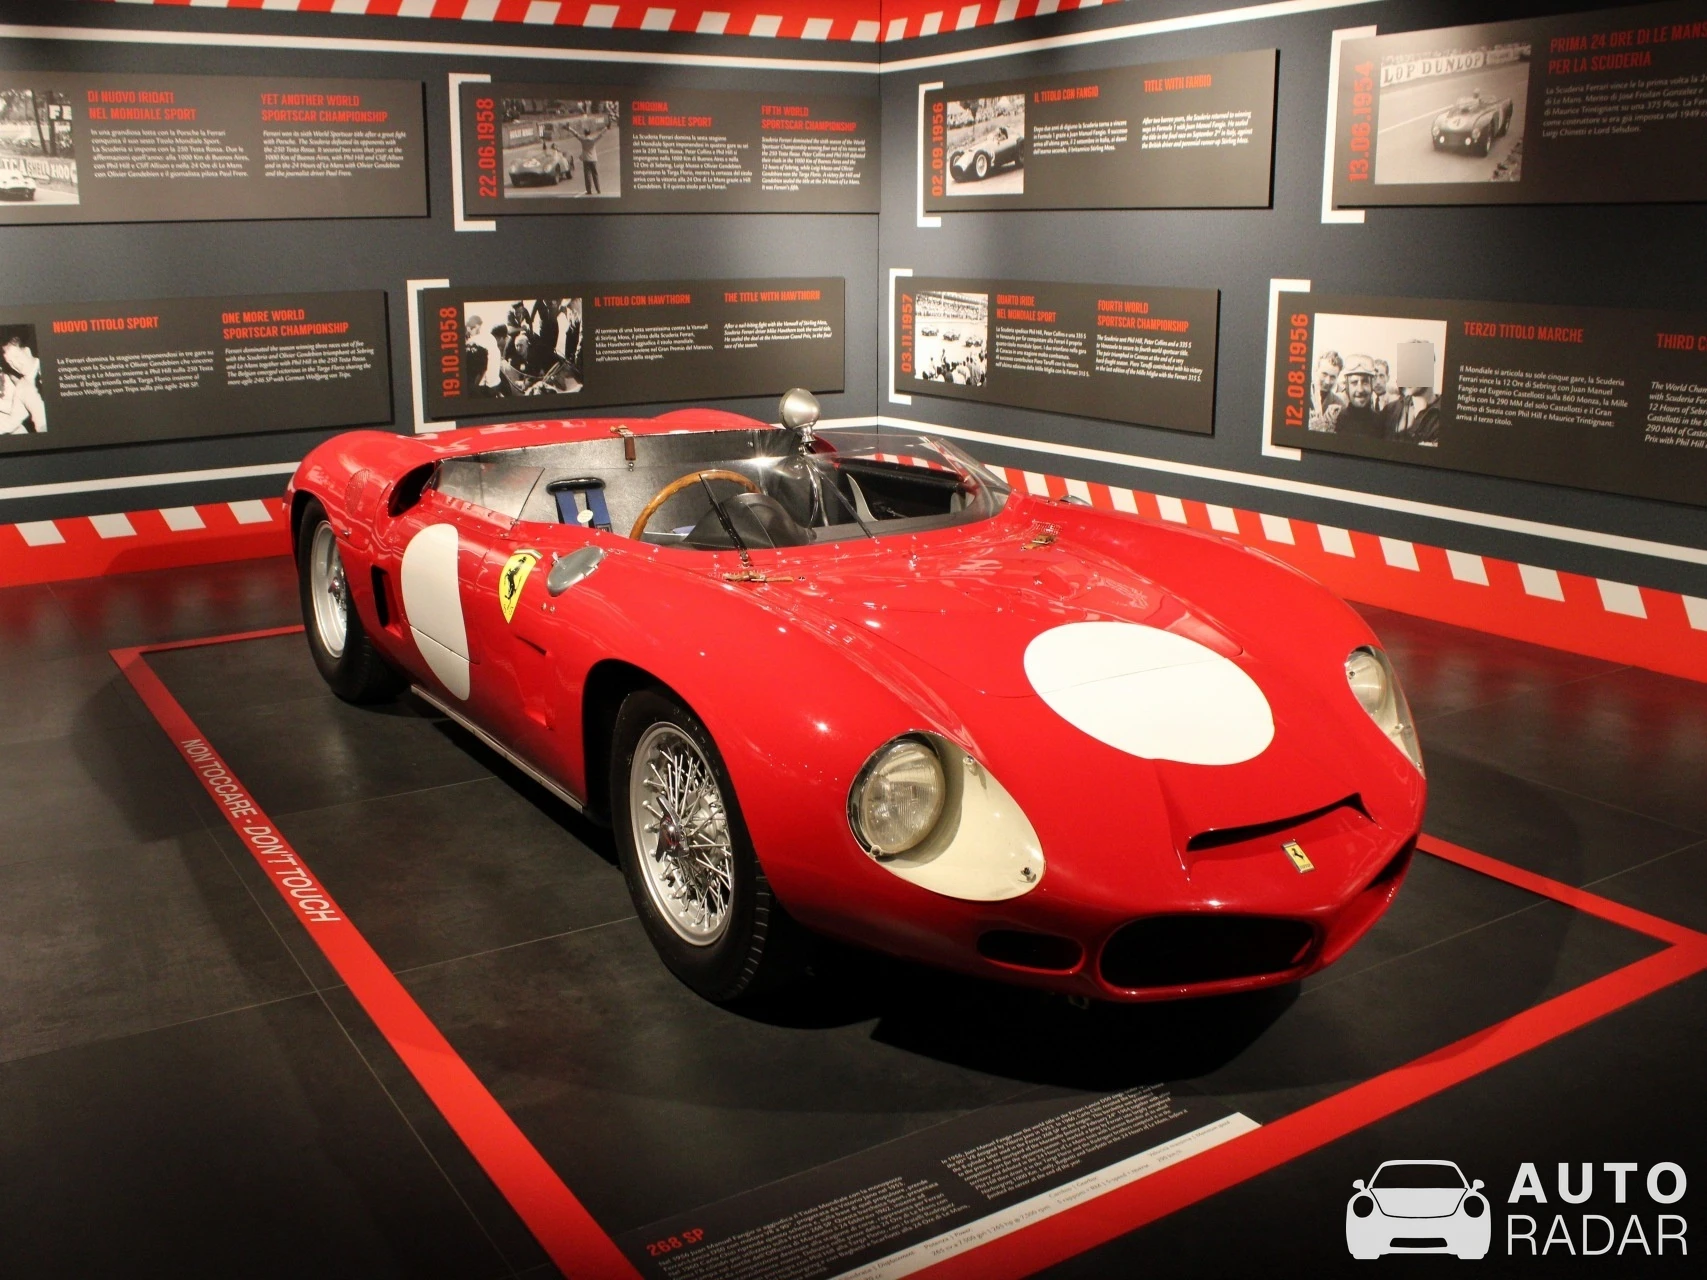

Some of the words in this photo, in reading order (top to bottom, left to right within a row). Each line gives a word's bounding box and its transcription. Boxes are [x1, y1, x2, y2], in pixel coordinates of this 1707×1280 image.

[1551, 35, 1587, 52] PRIMA
[1591, 33, 1605, 49] 24
[1610, 30, 1633, 47] ORE
[1637, 28, 1650, 44] DI
[1654, 27, 1667, 43] LE
[1672, 23, 1707, 41] MANS
[1384, 65, 1414, 83] LOP
[1422, 55, 1481, 74] DUNLOP
[1549, 58, 1569, 74] PER
[1574, 57, 1586, 72] LA
[1592, 52, 1651, 70] SCUDERIA
[1144, 79, 1163, 92] TITLE
[1165, 77, 1184, 90] WITH
[88, 91, 97, 103] DI
[101, 91, 135, 104] NUOVO
[139, 92, 174, 104] IRIDATI
[261, 94, 277, 105] YET
[282, 94, 323, 106] ANOTHER
[327, 95, 359, 106] WORLD
[1035, 92, 1040, 103] IL
[1041, 90, 1061, 102] TITOLO
[1063, 88, 1075, 100] CON
[89, 108, 107, 120] NEL
[111, 108, 161, 120] MONDIALE
[165, 108, 196, 120] SPORT
[262, 110, 316, 121] SPORTSCAR
[320, 111, 387, 122] CHAMPIONSHIP
[762, 106, 781, 115] FIFTH
[784, 106, 808, 116] WORLD
[633, 116, 645, 126] NEL
[648, 116, 686, 126] MONDIALE
[688, 117, 712, 127] SPORT
[762, 120, 802, 130] SPORTSCAR
[805, 121, 856, 131] CHAMPIONSHIP
[1349, 62, 1374, 182] 13.06.1954
[476, 98, 498, 198] 22.06.1958
[932, 102, 944, 196] 02.09.1956
[595, 297, 601, 307] IL
[604, 296, 629, 306] TITOLO
[631, 296, 646, 306] CON
[648, 294, 691, 305] HAWTHORN
[724, 293, 737, 302] THE
[740, 292, 758, 302] TITLE
[760, 291, 779, 301] WITH
[781, 290, 820, 301] HAWTHORN
[997, 294, 1018, 306] QUARTO
[1020, 295, 1034, 306] IRIDE
[997, 308, 1006, 320] NEL
[1008, 309, 1036, 322] MONDIALE
[1037, 311, 1056, 323] SPORT
[1098, 300, 1123, 312] FOURTH
[1124, 301, 1148, 313] WORLD
[53, 320, 87, 334] NUOVO
[90, 318, 124, 332] TITOLO
[127, 316, 158, 330] SPORT
[222, 312, 240, 324] ONE
[243, 311, 268, 323] MORE
[272, 309, 304, 322] WORLD
[1098, 316, 1136, 329] SPORTSCAR
[1137, 318, 1188, 333] CHAMPIONSHIP
[223, 326, 278, 340] SPORTSCAR
[281, 322, 348, 336] CHAMPIONSHIP
[902, 294, 913, 372] 03.11.1957
[1465, 322, 1496, 338] TERZO
[1499, 324, 1534, 340] TITOLO
[1537, 326, 1583, 343] MARCHE
[1657, 333, 1694, 350] THIRD
[439, 307, 460, 397] 19.10.1958
[1286, 314, 1308, 426] 12.08.1956
[1465, 366, 1493, 375] Mondiale
[1547, 373, 1568, 382] cinque
[1596, 377, 1624, 386] Scuderia
[1460, 375, 1478, 383] Ferrari
[1532, 382, 1556, 392] Sebring
[1570, 385, 1584, 394] Juan
[1587, 386, 1612, 395] Manuel
[1458, 394, 1475, 404] Miglia
[1549, 403, 1582, 413] Castellotti
[1594, 408, 1611, 416] Gran
[1459, 385, 1478, 394] Fangio
[1487, 387, 1511, 397] Eugenio
[1512, 390, 1544, 399] Castellotti
[1576, 396, 1601, 406] Monza,
[1610, 399, 1628, 407] Mille
[1457, 404, 1477, 412] Premio
[1485, 407, 1503, 415] Svezia
[1548, 414, 1573, 423] Maurice
[1576, 416, 1614, 427] Trintignant:
[182, 738, 214, 763] NON
[198, 762, 257, 818] TOCCARE
[243, 826, 297, 866] DON'T
[276, 867, 341, 922] TOUCH
[646, 1236, 682, 1256] 268
[683, 1228, 704, 1244] SP
